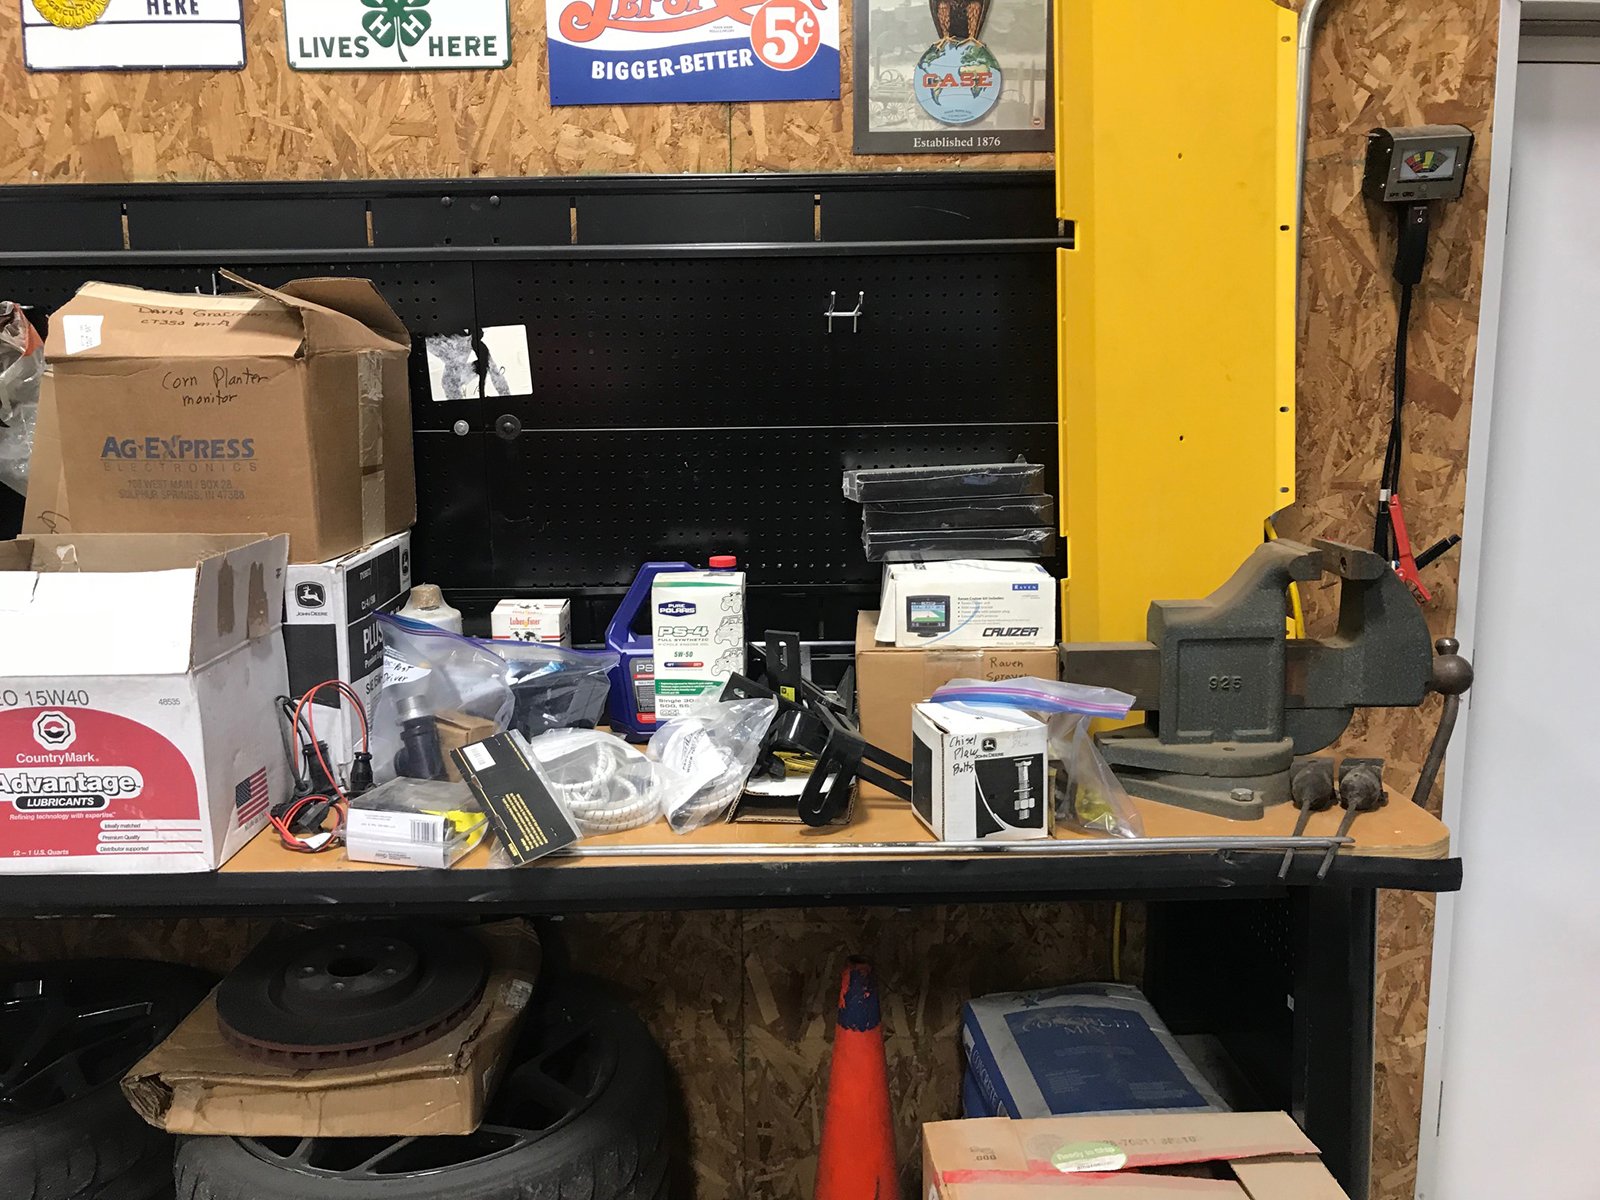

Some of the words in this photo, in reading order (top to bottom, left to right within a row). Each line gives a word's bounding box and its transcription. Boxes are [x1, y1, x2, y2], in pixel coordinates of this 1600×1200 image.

[299, 36, 370, 58] LIVES
[428, 35, 498, 57] HERE
[591, 48, 754, 81] BIGGER-BETTER
[922, 72, 993, 88] CASE
[913, 136, 974, 148] Established
[976, 136, 1002, 147] 1876
[161, 371, 198, 390] Corn
[212, 365, 270, 389] Planter
[182, 389, 238, 407] monitor
[103, 462, 258, 473] ELECTRONICS
[657, 625, 709, 637] PS-4
[982, 627, 1039, 637] CRUIZER
[989, 656, 1024, 669] Raven
[25, 689, 90, 707] 15W40
[0, 773, 137, 796] Advantage
[26, 797, 95, 808] LUBRICANTS
[36, 813, 70, 821] technology
